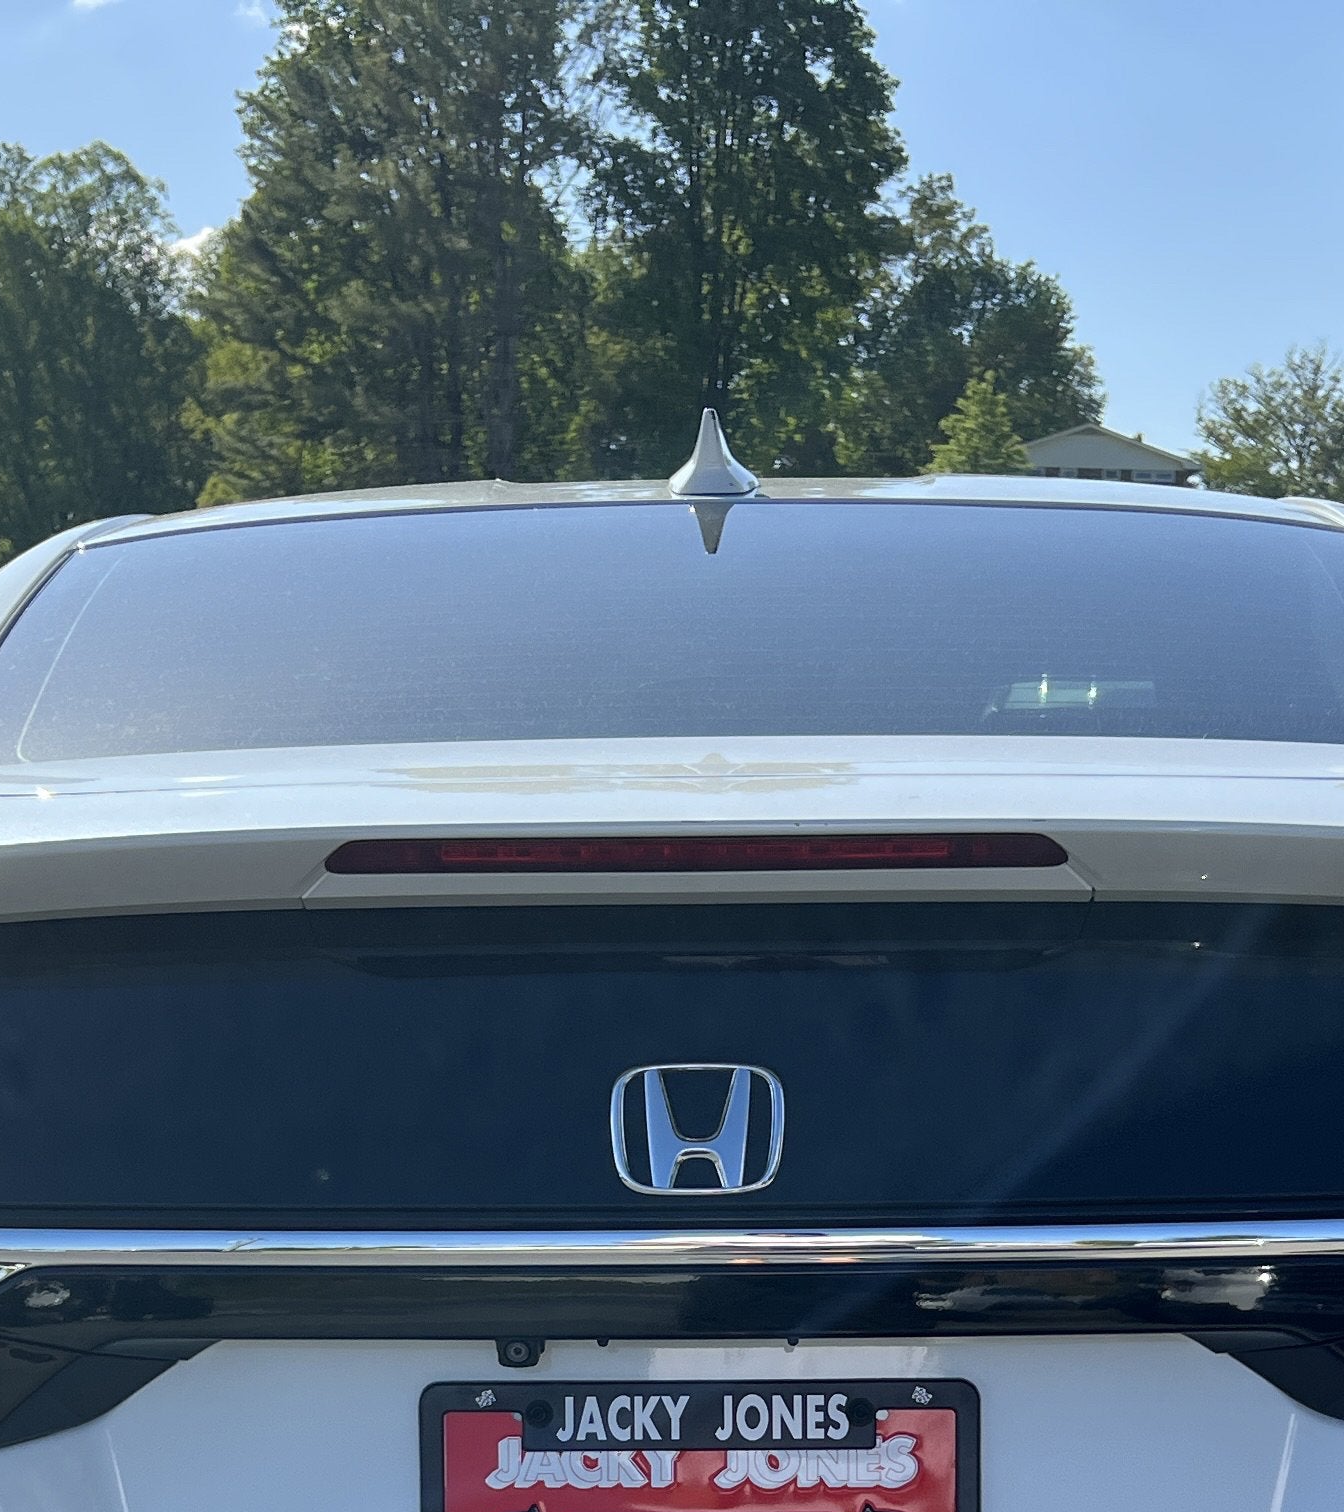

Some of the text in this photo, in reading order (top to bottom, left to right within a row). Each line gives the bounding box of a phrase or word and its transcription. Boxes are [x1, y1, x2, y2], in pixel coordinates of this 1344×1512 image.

[556, 1393, 850, 1442] JACKY JONES
[485, 1434, 919, 1489] JACKY JONES
